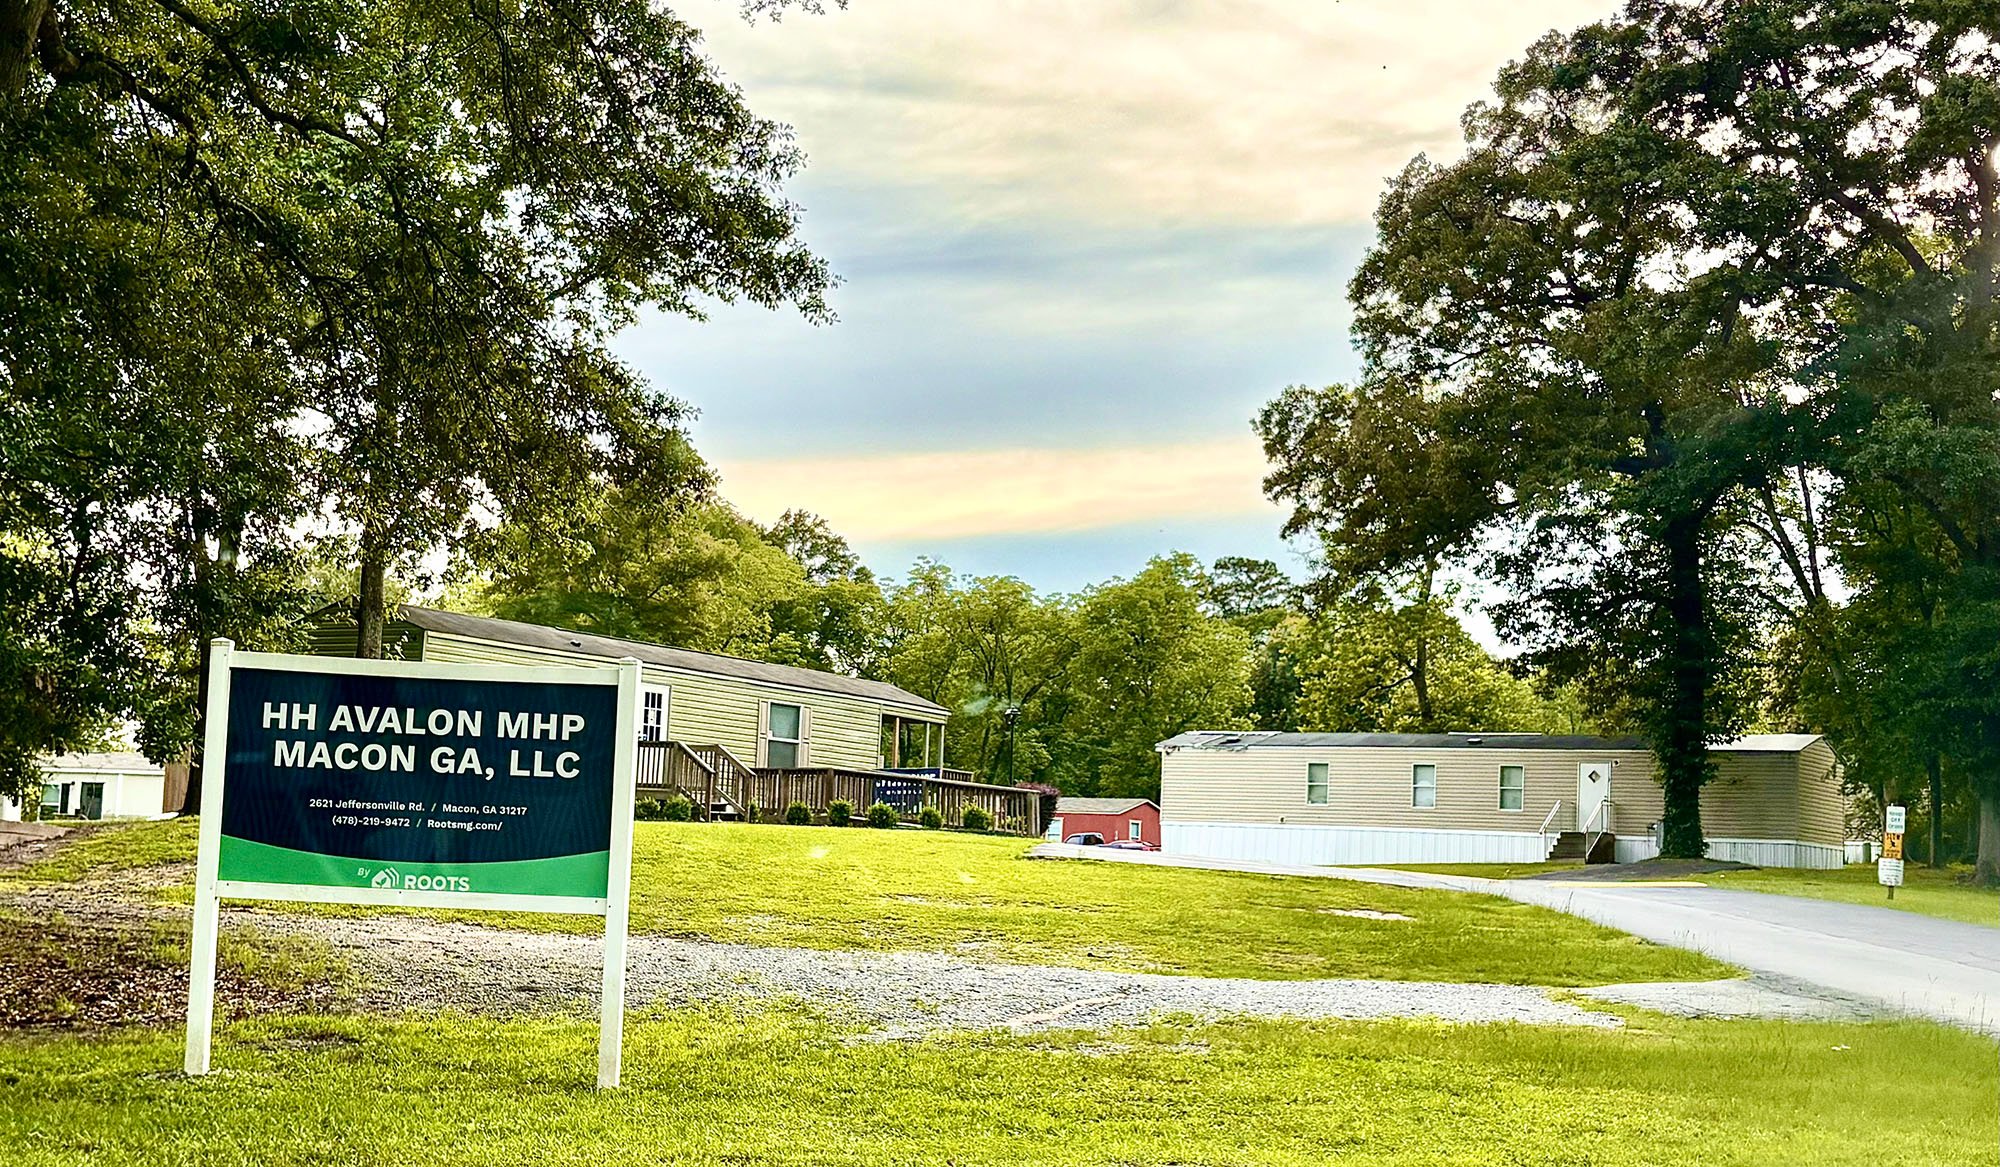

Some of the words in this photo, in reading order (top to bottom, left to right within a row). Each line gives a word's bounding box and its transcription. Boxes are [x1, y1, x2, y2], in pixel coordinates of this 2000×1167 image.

[263, 701, 317, 731] HH
[329, 704, 482, 737] AVALON
[497, 711, 585, 741] MHP
[274, 739, 415, 773] MACON
[430, 746, 495, 781] GA,
[509, 749, 580, 779] LLC
[309, 798, 333, 808] 2621
[335, 799, 406, 811] Jeffersonville
[408, 801, 425, 812] Rd.
[431, 802, 437, 812] /
[442, 803, 480, 815] Macon,
[482, 805, 497, 814] GA
[499, 806, 528, 816] 31217
[332, 814, 410, 827] (478)-219-9472
[416, 818, 422, 828] /
[427, 819, 503, 832] Rootsmg.com/
[357, 867, 370, 878] By
[404, 874, 470, 892] ROOTS
